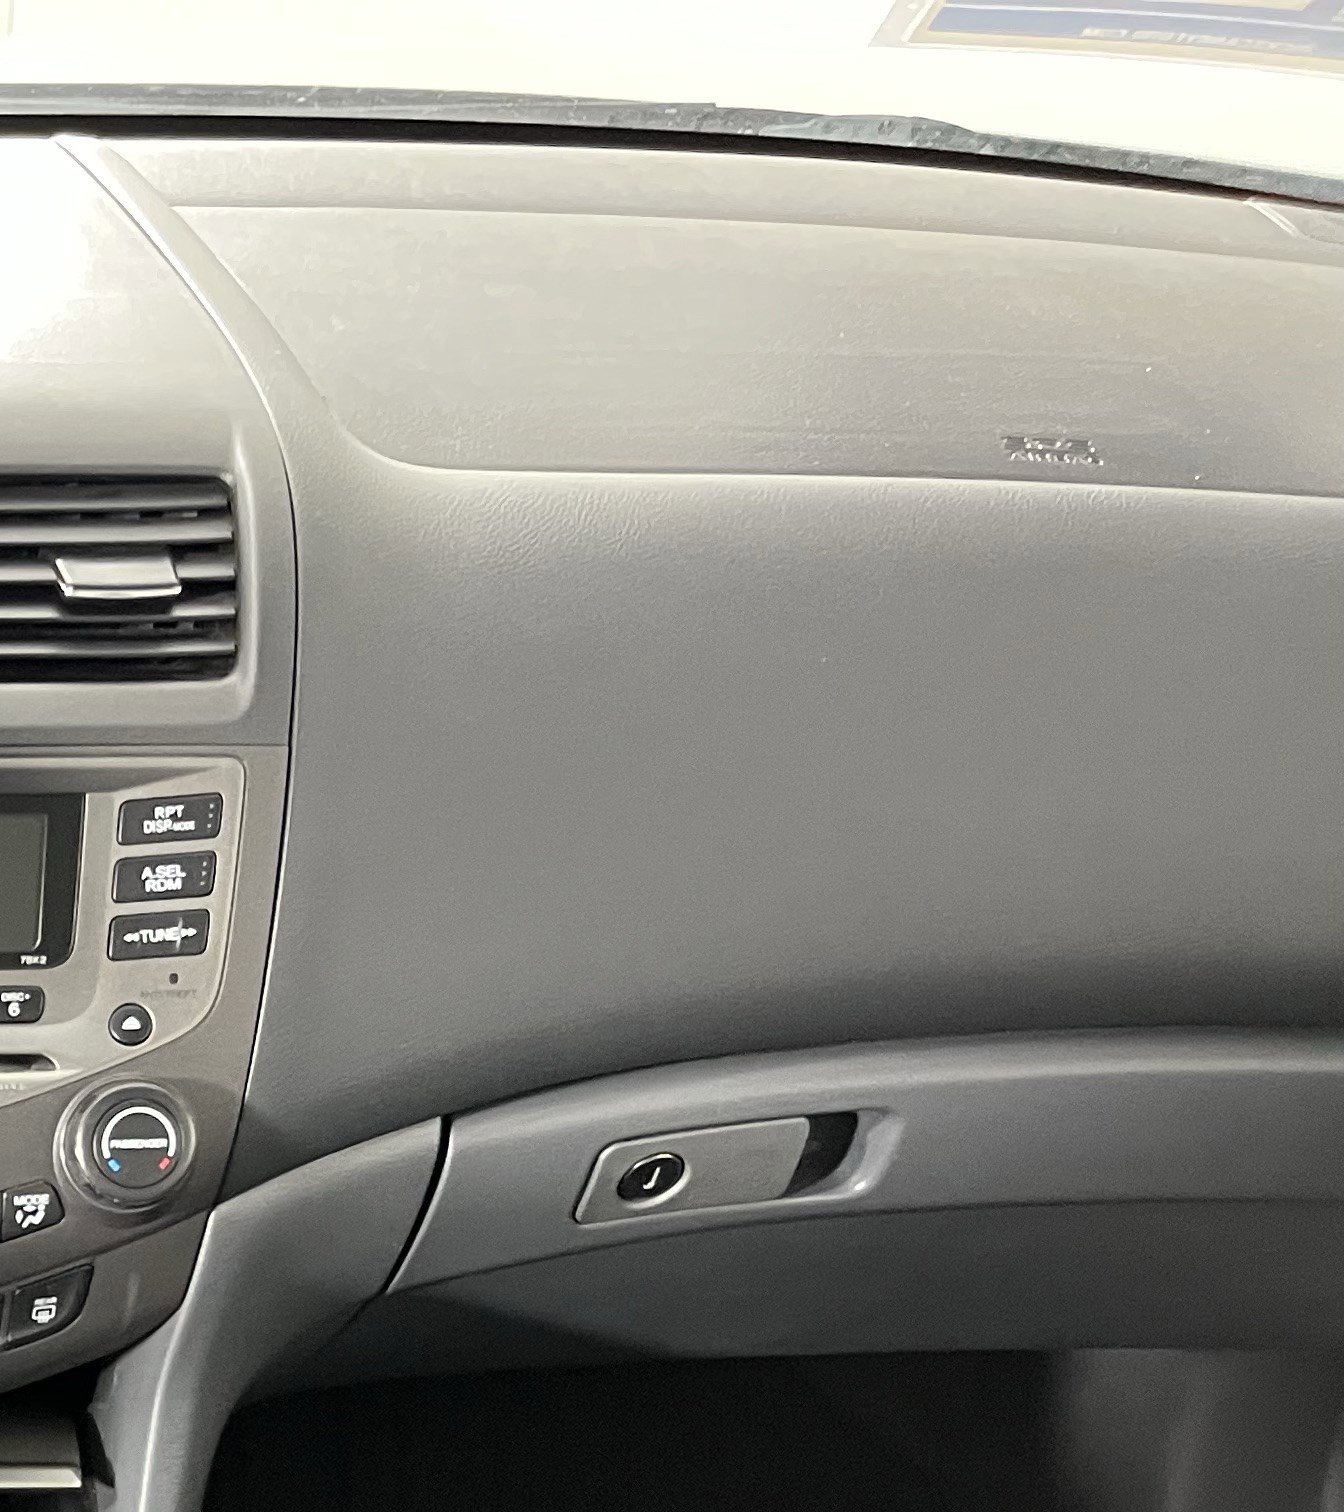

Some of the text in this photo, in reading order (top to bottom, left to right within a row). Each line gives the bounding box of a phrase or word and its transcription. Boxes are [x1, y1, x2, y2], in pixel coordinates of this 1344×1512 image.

[154, 805, 184, 819] RPT
[145, 878, 182, 892] RDM
[139, 928, 180, 944] TUNE
[8, 1002, 20, 1017] 6
[13, 1194, 50, 1206] MODE
